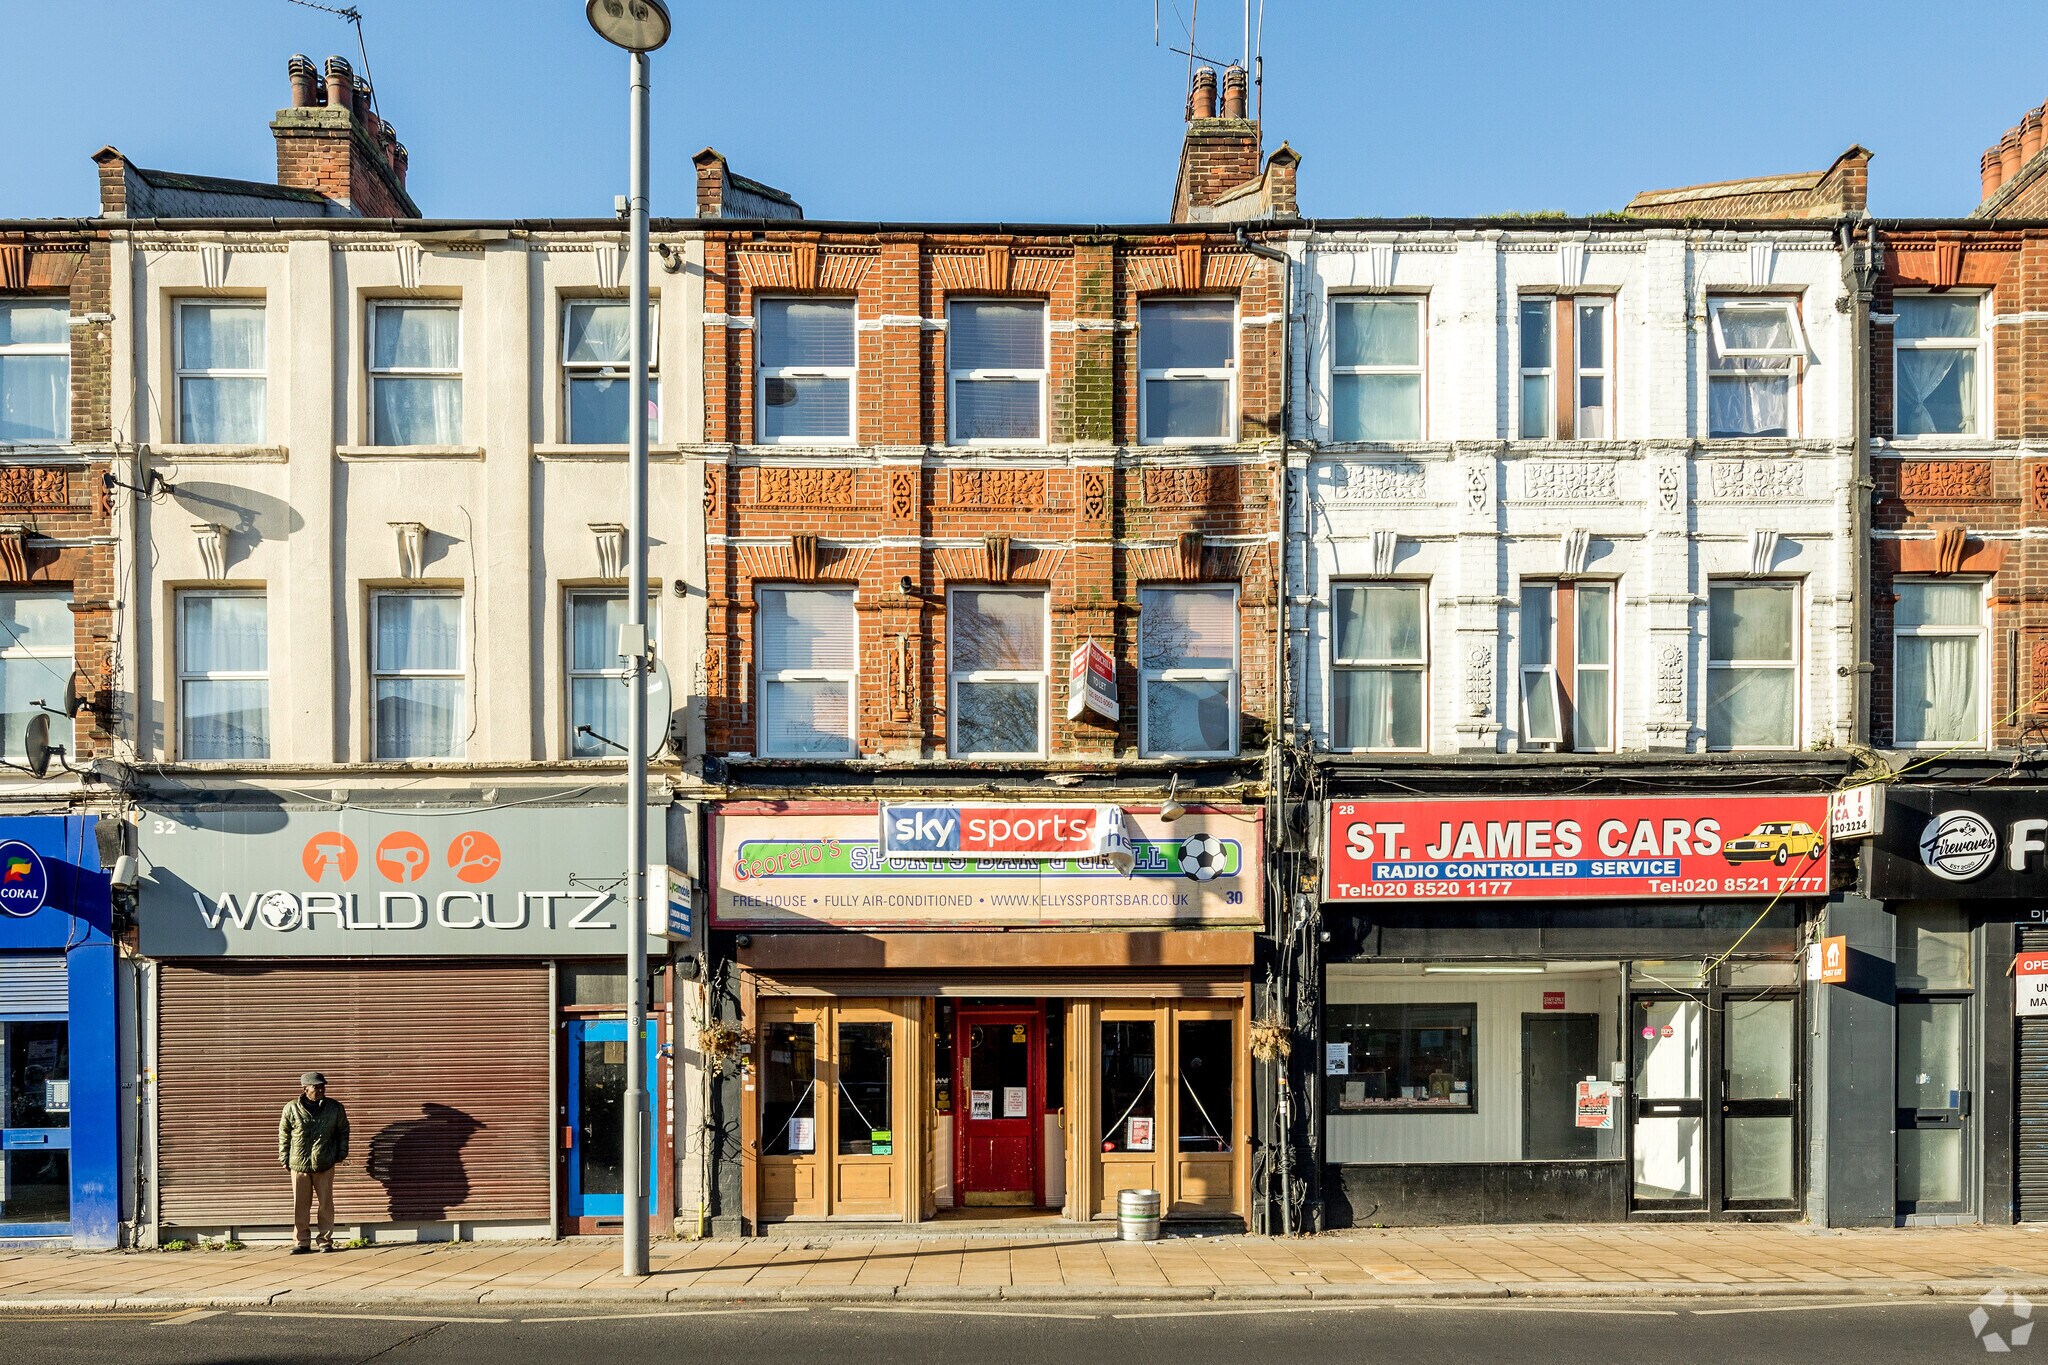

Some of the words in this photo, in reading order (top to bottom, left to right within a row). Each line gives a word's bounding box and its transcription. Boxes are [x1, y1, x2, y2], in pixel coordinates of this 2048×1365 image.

[1093, 676, 1099, 687] TO
[1099, 681, 1107, 692] LET
[1339, 805, 1355, 815] 28
[153, 821, 177, 835] 32
[895, 811, 955, 847] sky
[968, 814, 1087, 848] sports
[1345, 821, 1411, 860] ST.
[1426, 818, 1583, 860] JAMES
[1597, 817, 1722, 857] CARS
[733, 837, 841, 881] Georgio's
[1376, 864, 1439, 879] RADIO
[1444, 862, 1578, 878] CONTROLLED
[1591, 861, 1676, 876] SERVICE
[1338, 882, 1408, 897] Tel:020
[1413, 882, 1460, 896] 8520
[1466, 881, 1513, 895] 1177
[1648, 878, 1718, 893] Tel:020
[1724, 878, 1769, 891] 8521
[1776, 877, 1823, 891] 7777
[0, 888, 39, 899] CORAL
[733, 895, 761, 907] FREE
[765, 895, 807, 907] HOUSE
[825, 895, 860, 907] FULLY
[862, 894, 973, 907] AIR-CONDITIONED
[990, 893, 1189, 907] WWW.KELLYSSPORTSBAR.CO.UK
[1226, 890, 1243, 905] 30
[193, 889, 424, 931] WORLD
[436, 890, 614, 929] CUTZ
[1833, 968, 1843, 976] EAT
[632, 1016, 639, 1026] 8
